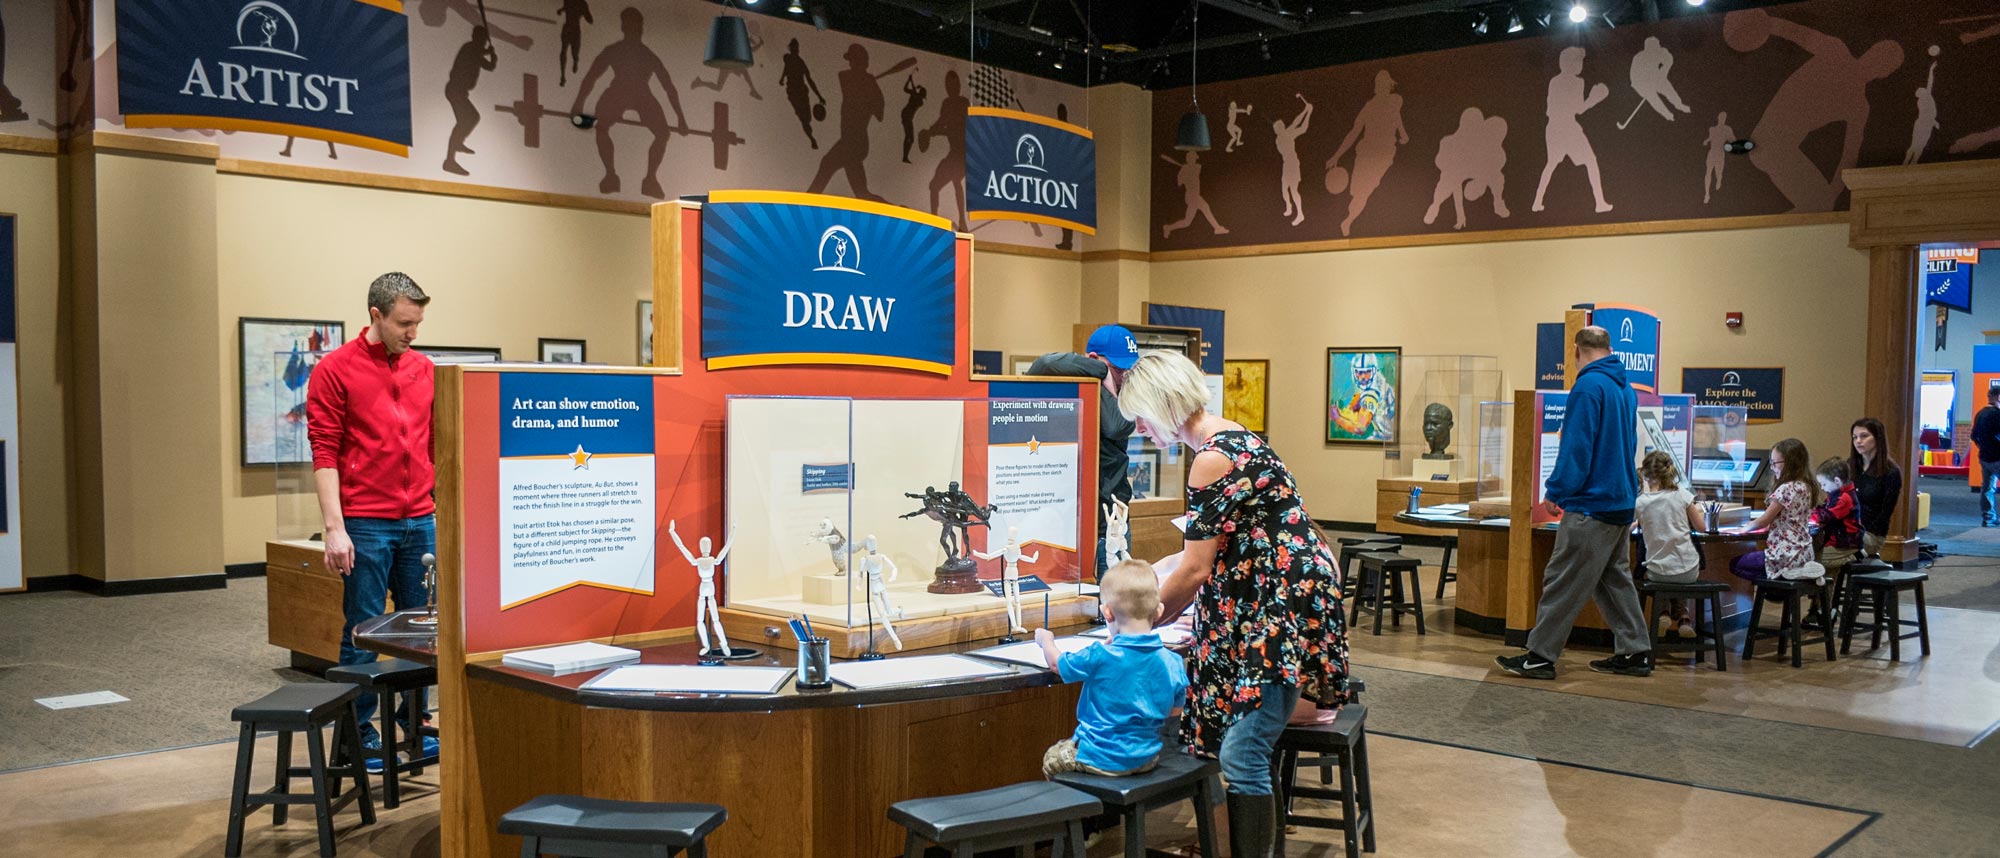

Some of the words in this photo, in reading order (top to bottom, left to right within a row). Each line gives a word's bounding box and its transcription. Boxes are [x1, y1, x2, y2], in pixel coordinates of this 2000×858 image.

[180, 58, 359, 115] ARTIST
[984, 170, 1078, 210] ACTION
[783, 290, 896, 332] DRAW
[1125, 336, 1138, 352] LA
[1706, 388, 1740, 398] Explore
[1742, 388, 1756, 397] the
[512, 398, 533, 410] Art
[536, 400, 556, 410] can
[560, 397, 588, 410] show
[590, 398, 640, 411] emotion,
[993, 401, 1032, 412] Experiment
[1033, 400, 1046, 408] with
[1048, 400, 1074, 411] drawing
[1730, 400, 1774, 410] collection
[512, 416, 554, 430] drama,
[558, 416, 578, 428] and
[581, 416, 620, 428] humor
[993, 414, 1015, 425] people
[1016, 414, 1024, 422] in
[1024, 414, 1048, 422] motion
[558, 529, 580, 537] subject
[514, 550, 548, 559] playfulness
